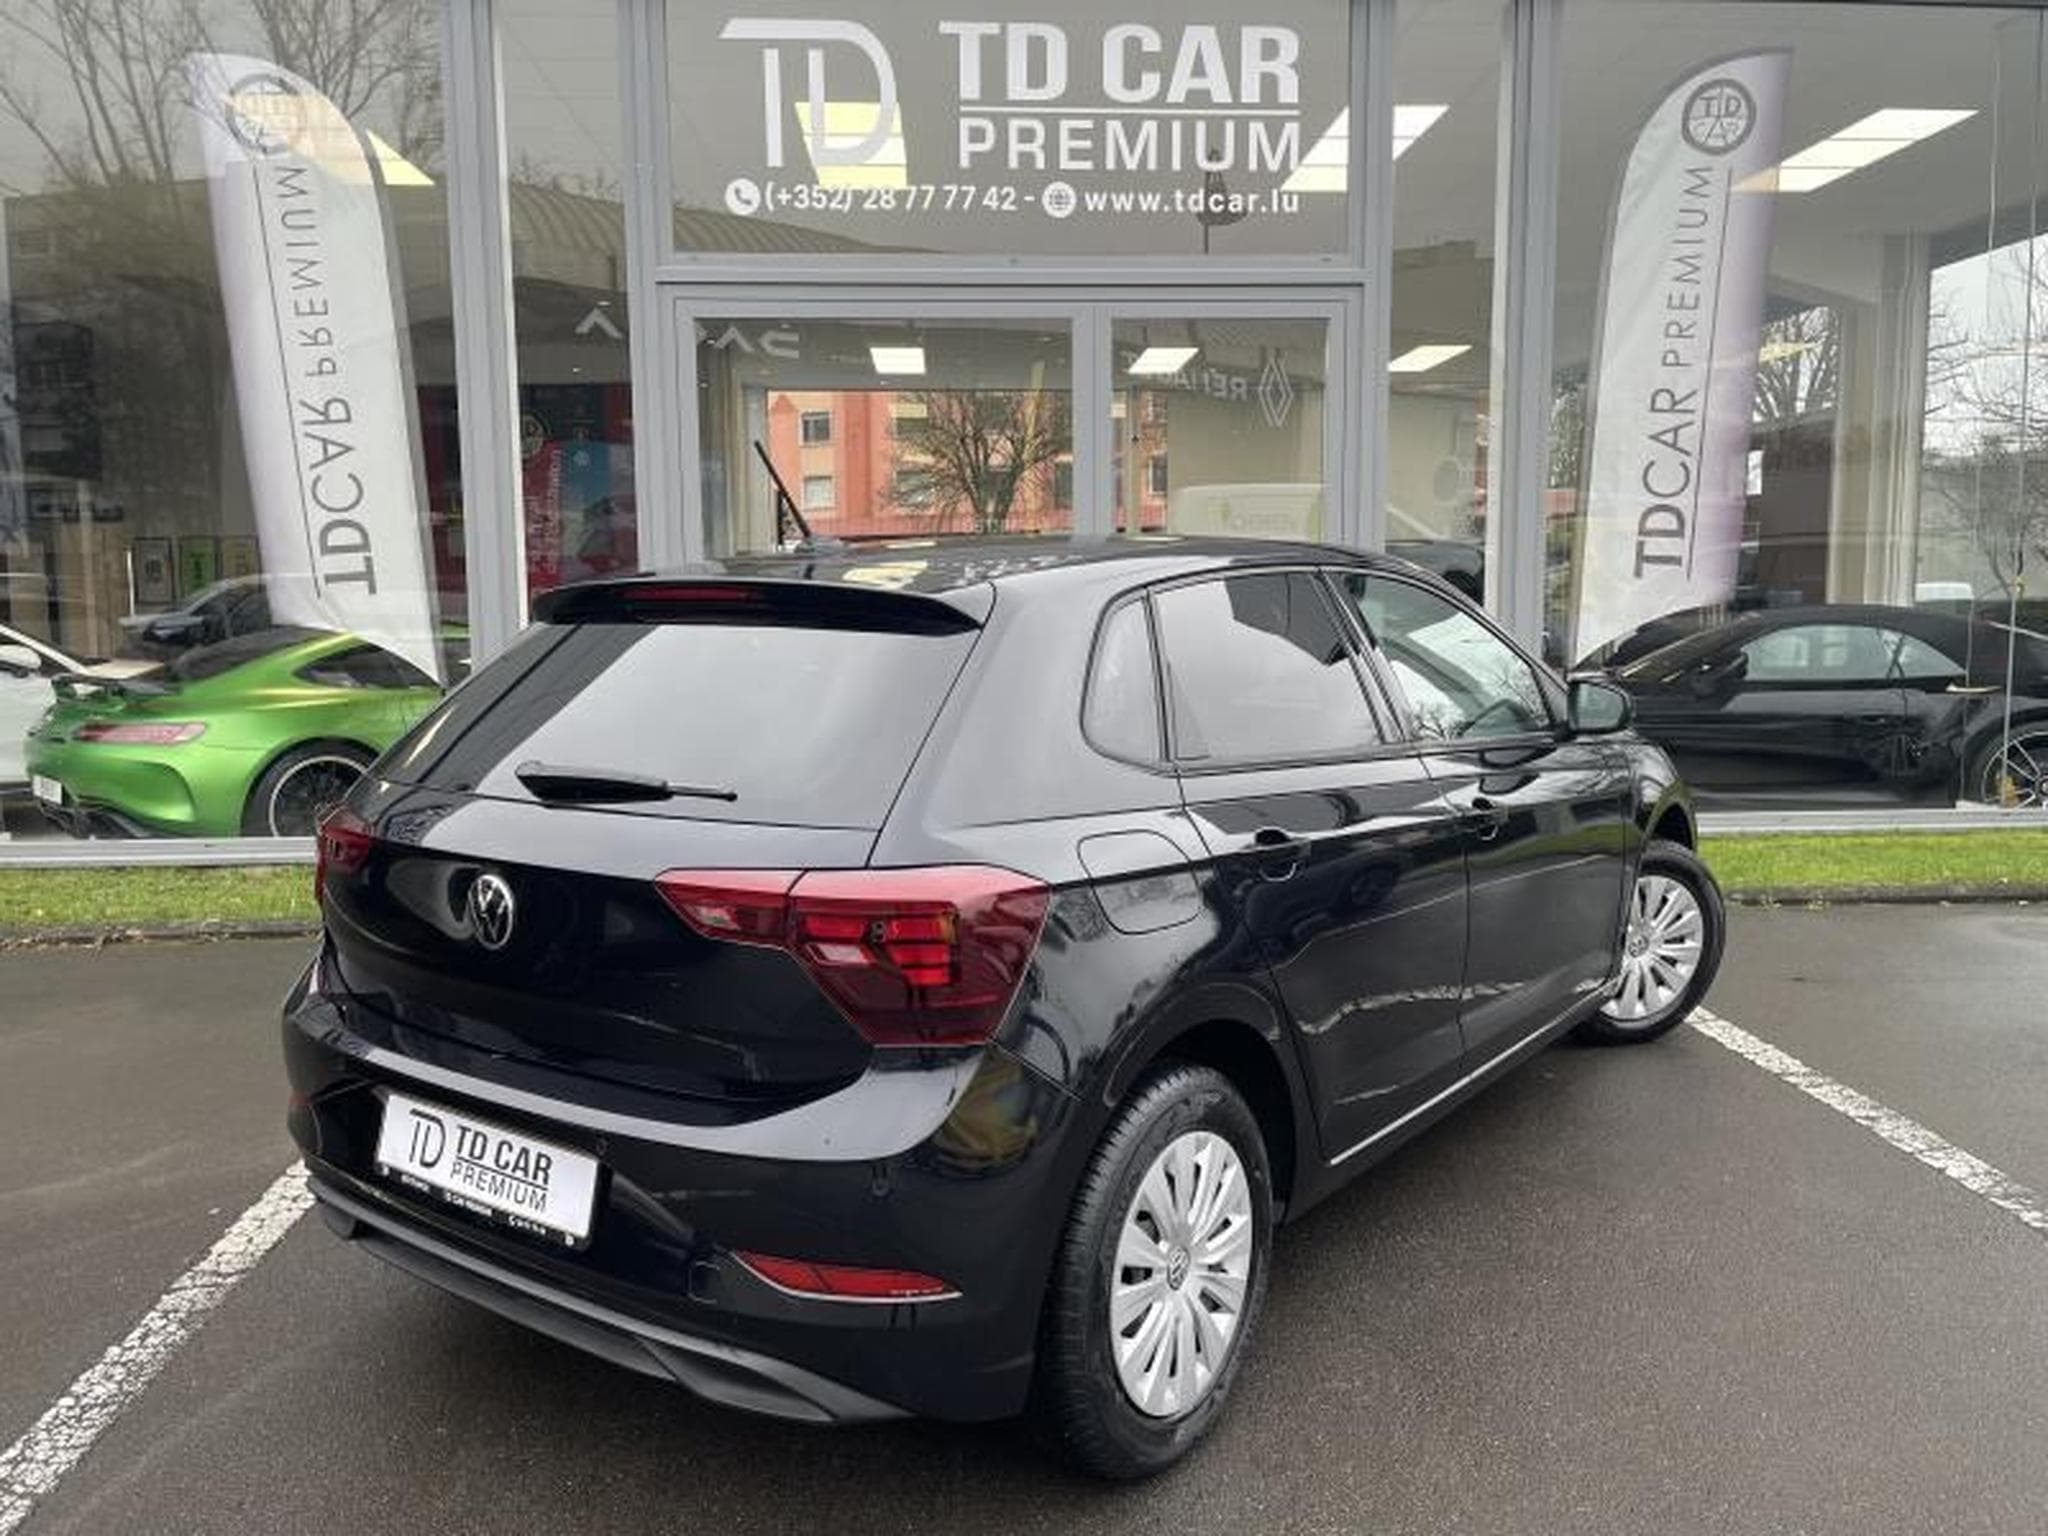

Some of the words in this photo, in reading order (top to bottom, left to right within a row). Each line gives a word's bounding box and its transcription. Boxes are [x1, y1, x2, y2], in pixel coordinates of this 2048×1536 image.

[939, 21, 1067, 101] TD
[1102, 23, 1300, 103] CAR
[960, 119, 1300, 171] PREMIUM
[765, 181, 852, 213] (+352)
[862, 186, 897, 211] 28
[905, 186, 935, 212] 77
[943, 186, 976, 212] 77
[982, 186, 1017, 211] 42
[1084, 188, 1299, 213] www.tdcar.lu
[1661, 166, 1713, 368] PREMIUM
[456, 1125, 488, 1161] TD
[494, 1140, 553, 1186] CAR
[450, 1162, 549, 1213] PREMIUM
